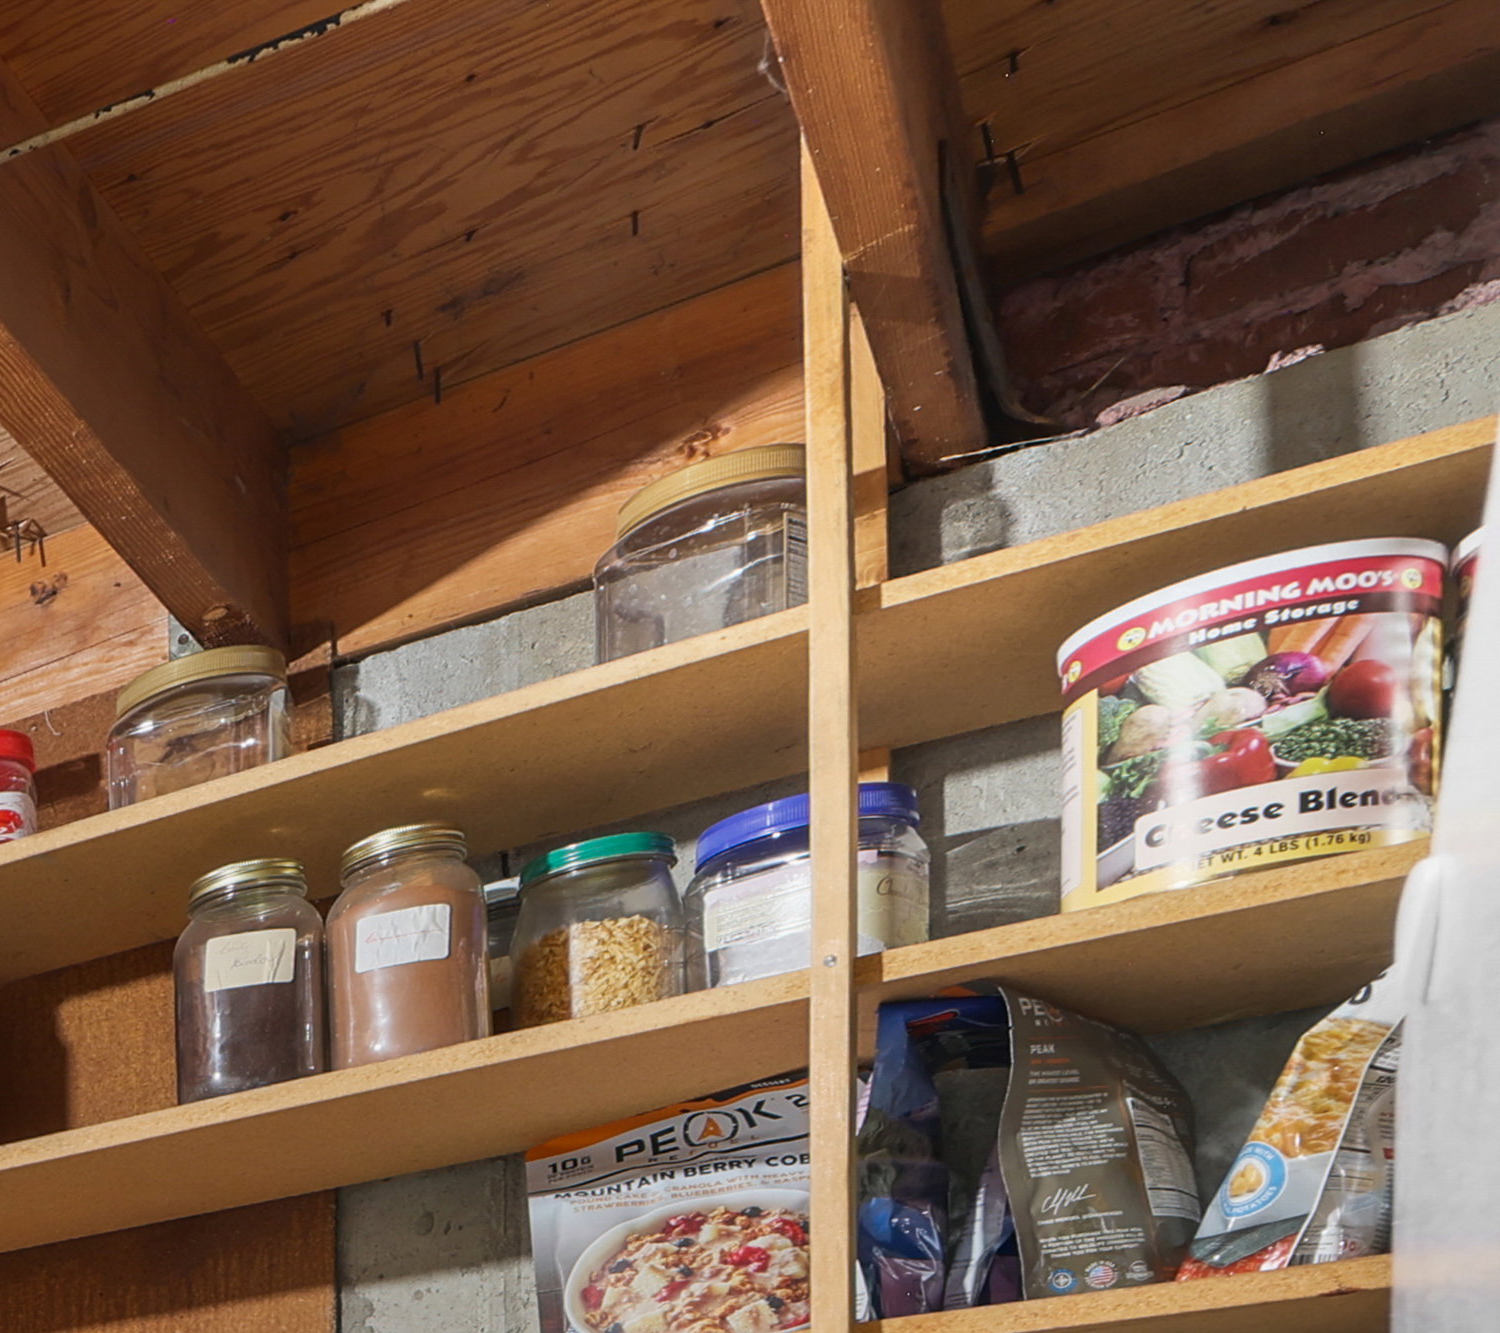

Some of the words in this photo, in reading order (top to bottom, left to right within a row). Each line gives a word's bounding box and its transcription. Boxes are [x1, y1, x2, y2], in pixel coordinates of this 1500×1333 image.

[1148, 582, 1302, 639] MORNING
[1306, 570, 1394, 595] MOO'S
[1188, 618, 1256, 646] Home
[1264, 598, 1360, 625] Storage
[1270, 841, 1299, 854] LBS
[554, 1170, 675, 1199] MOUNTAIN
[684, 1158, 756, 1178] BERRY
